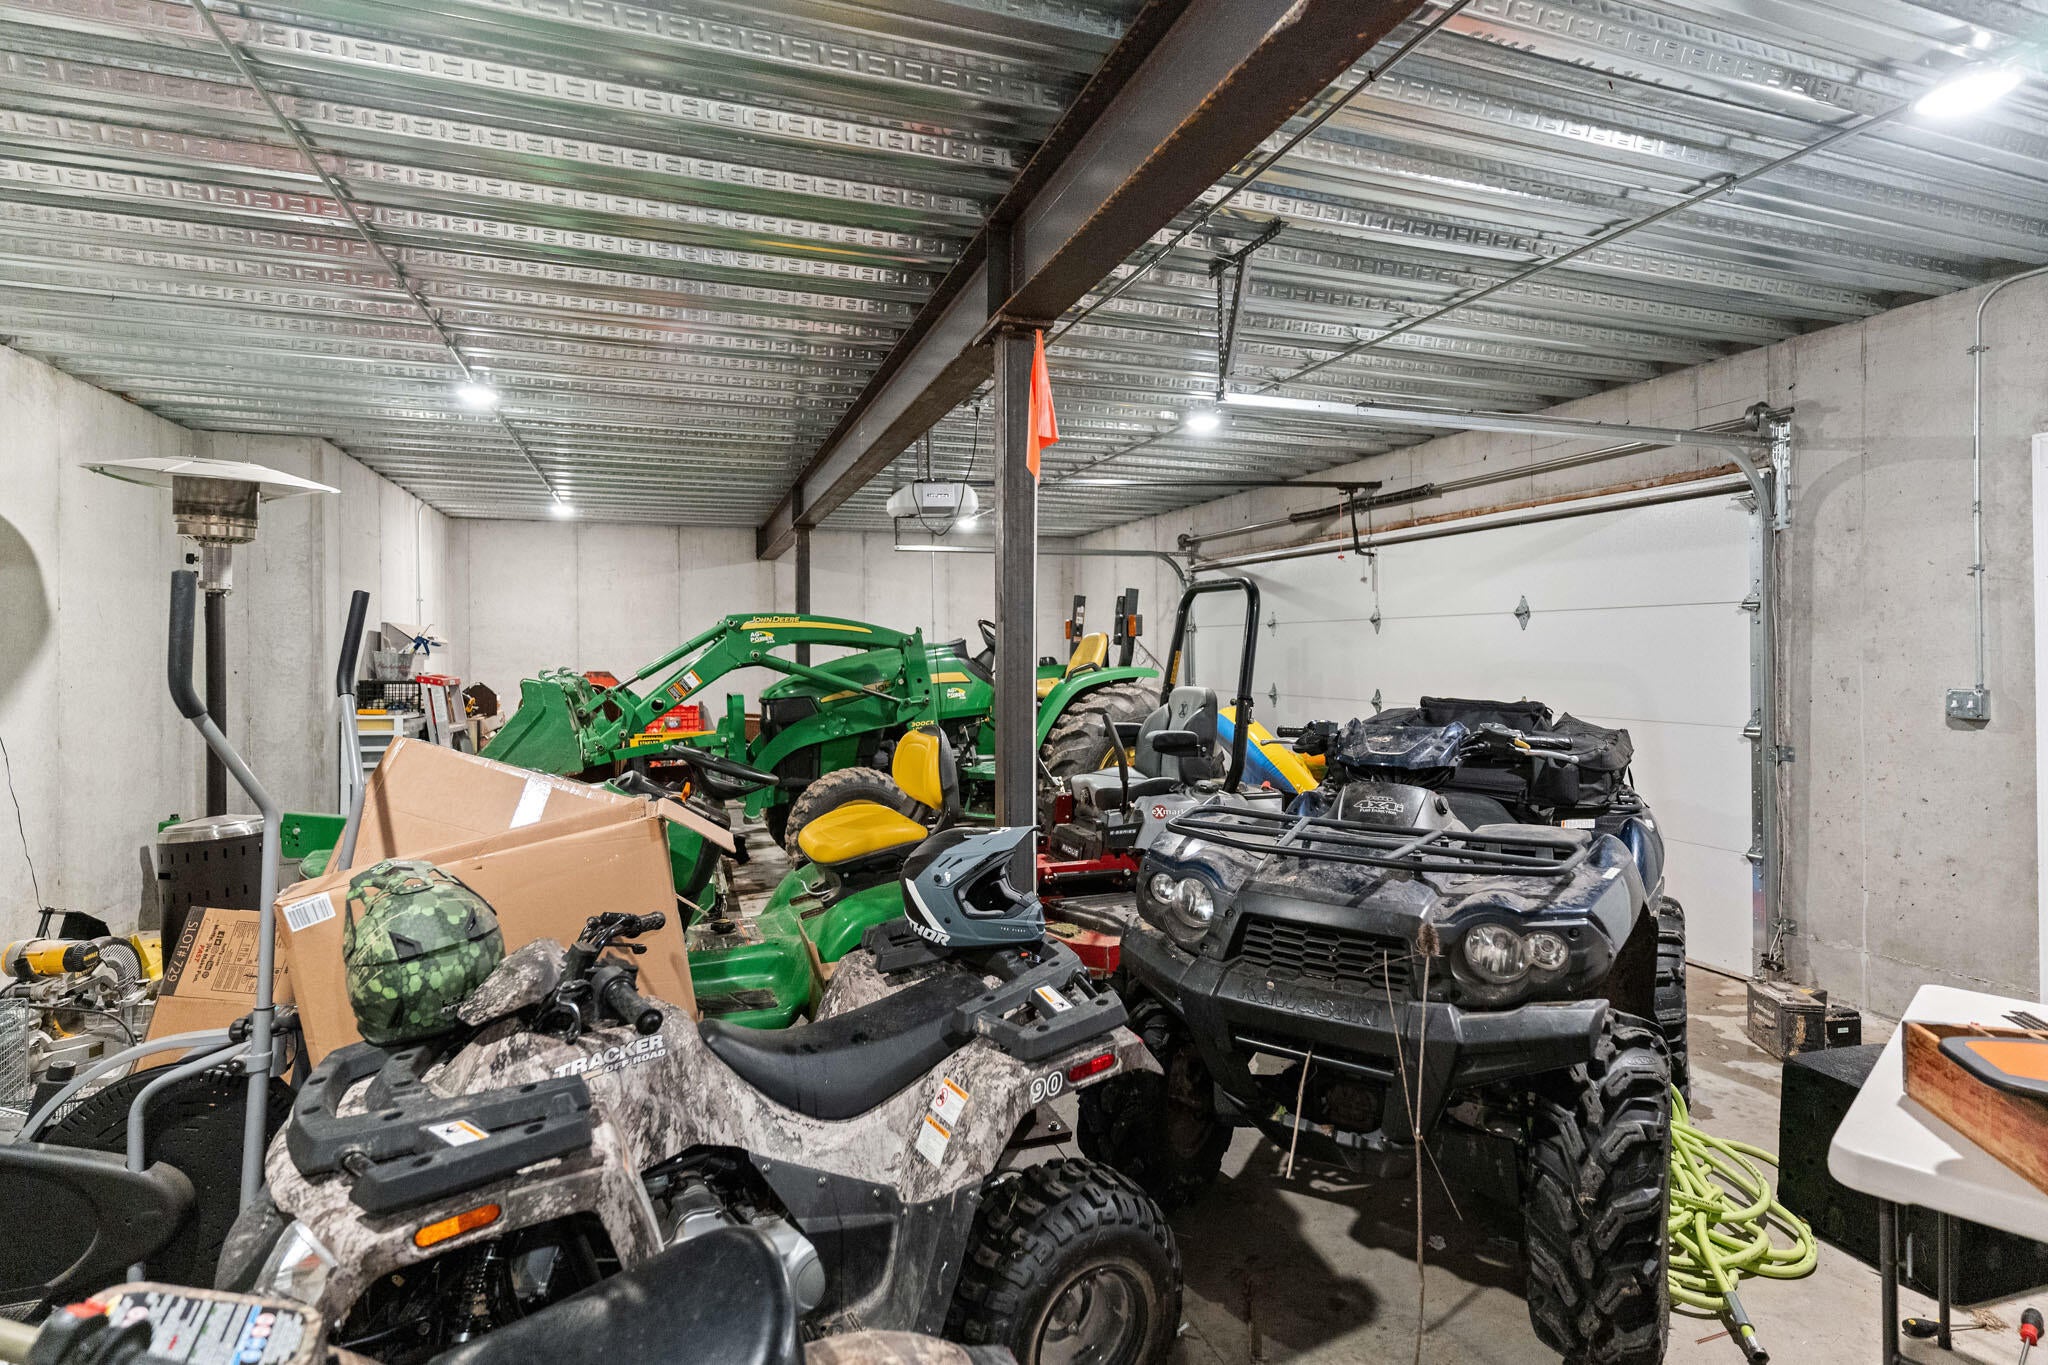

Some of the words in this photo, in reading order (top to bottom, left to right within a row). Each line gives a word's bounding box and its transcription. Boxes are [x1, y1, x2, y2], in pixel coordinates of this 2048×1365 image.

[176, 920, 199, 958] SLOT#
[908, 920, 951, 947] THOR
[167, 960, 184, 983] 729
[554, 1034, 664, 1078] TRACKER
[605, 1060, 631, 1074] OFF
[633, 1048, 667, 1065] ROAD
[1030, 1071, 1063, 1104] 90
